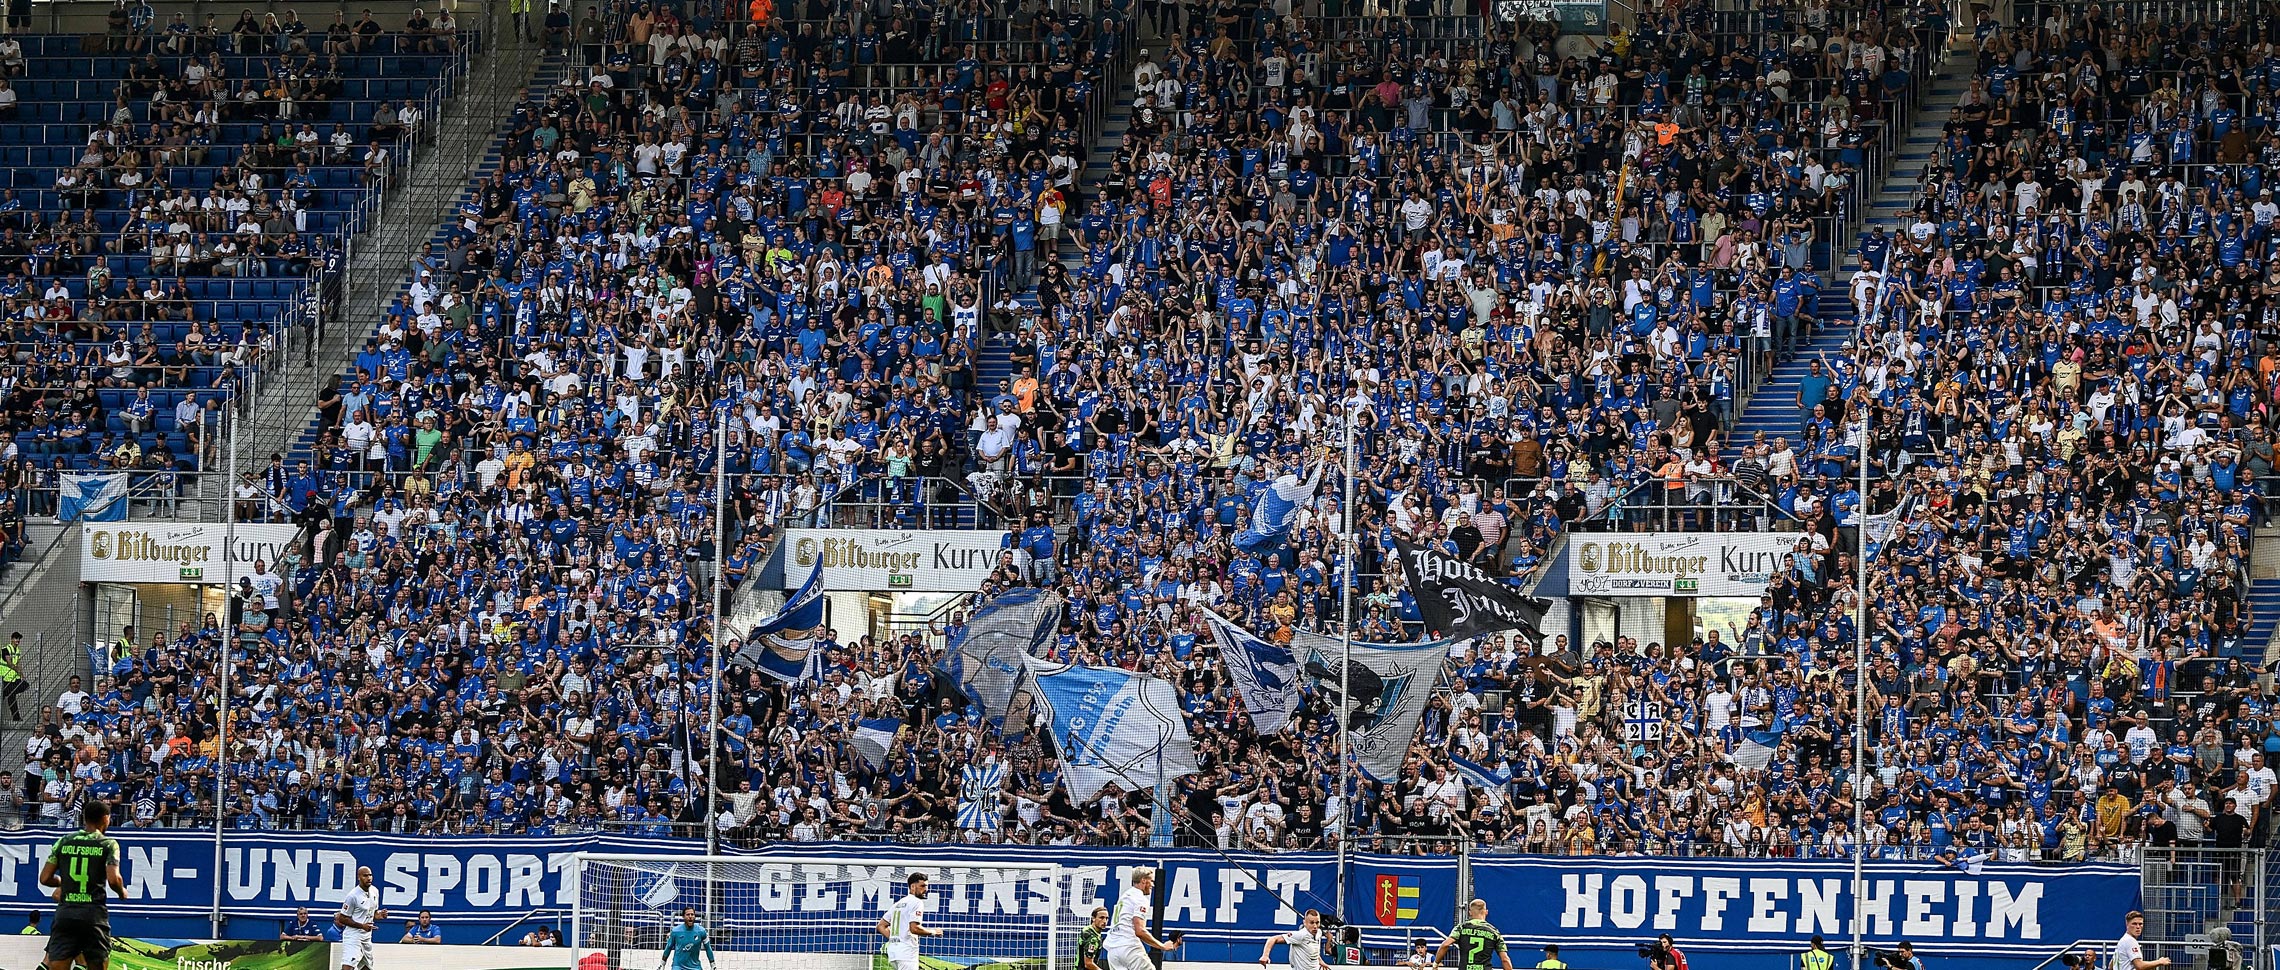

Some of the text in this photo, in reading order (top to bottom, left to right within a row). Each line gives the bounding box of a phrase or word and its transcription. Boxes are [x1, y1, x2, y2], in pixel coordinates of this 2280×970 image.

[115, 531, 212, 566] Bitburger
[823, 537, 921, 573] Bitburger
[1606, 542, 1784, 578] Bitburger Kurv
[1640, 580, 1669, 588] VEREIN
[1086, 696, 1137, 766] Hffenheim
[61, 845, 104, 856] WOLFSBURG
[0, 844, 587, 908] TUN- UND SPORT
[69, 857, 89, 893] 4
[1561, 873, 2044, 940] HOFFENHEIM
[1461, 929, 1495, 940] WOLFSBURG
[177, 956, 231, 970] frische
